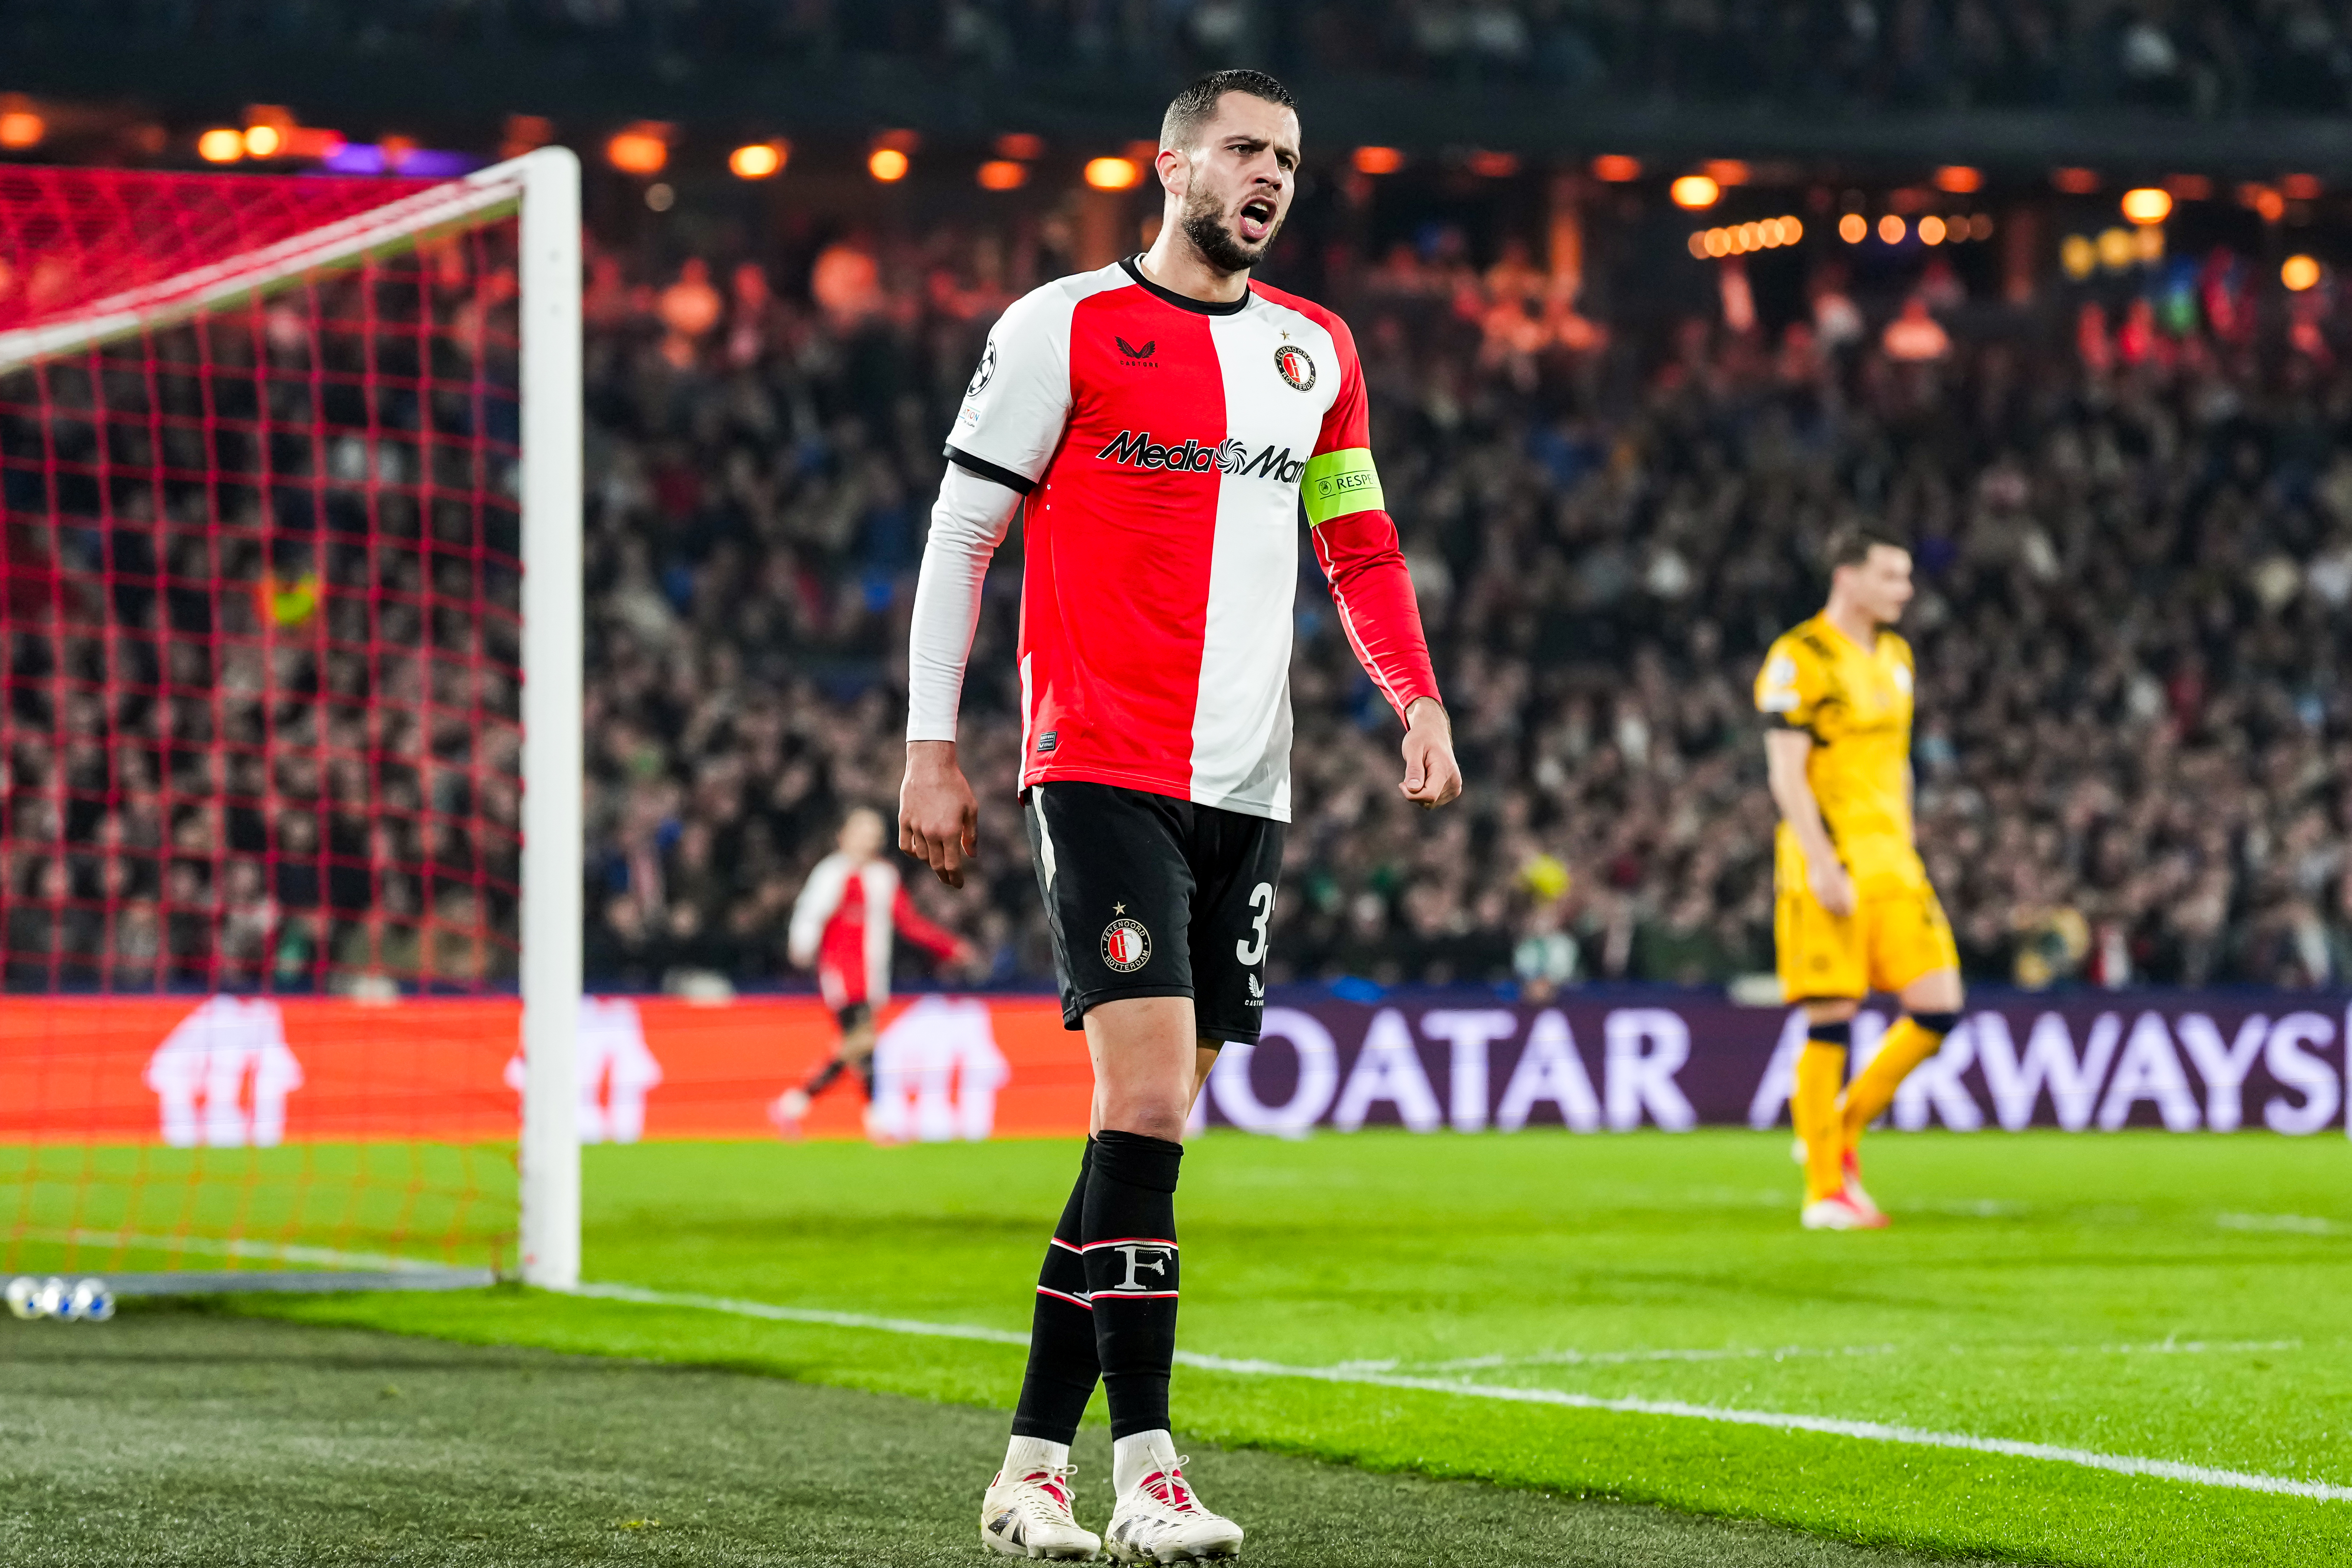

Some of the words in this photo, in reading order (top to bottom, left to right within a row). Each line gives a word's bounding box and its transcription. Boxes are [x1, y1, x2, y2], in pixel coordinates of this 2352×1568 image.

[1276, 346, 1311, 363] FEYENOORD
[1281, 372, 1315, 390] ROTTERDAM
[1096, 430, 1215, 473] Media
[1103, 921, 1145, 941] FEYENOORD
[1236, 882, 1278, 968] 3
[1114, 933, 1133, 958] F
[1105, 950, 1149, 970] ROTTERDAM
[1209, 1007, 1697, 1139] QATAR
[1114, 1246, 1172, 1290] F
